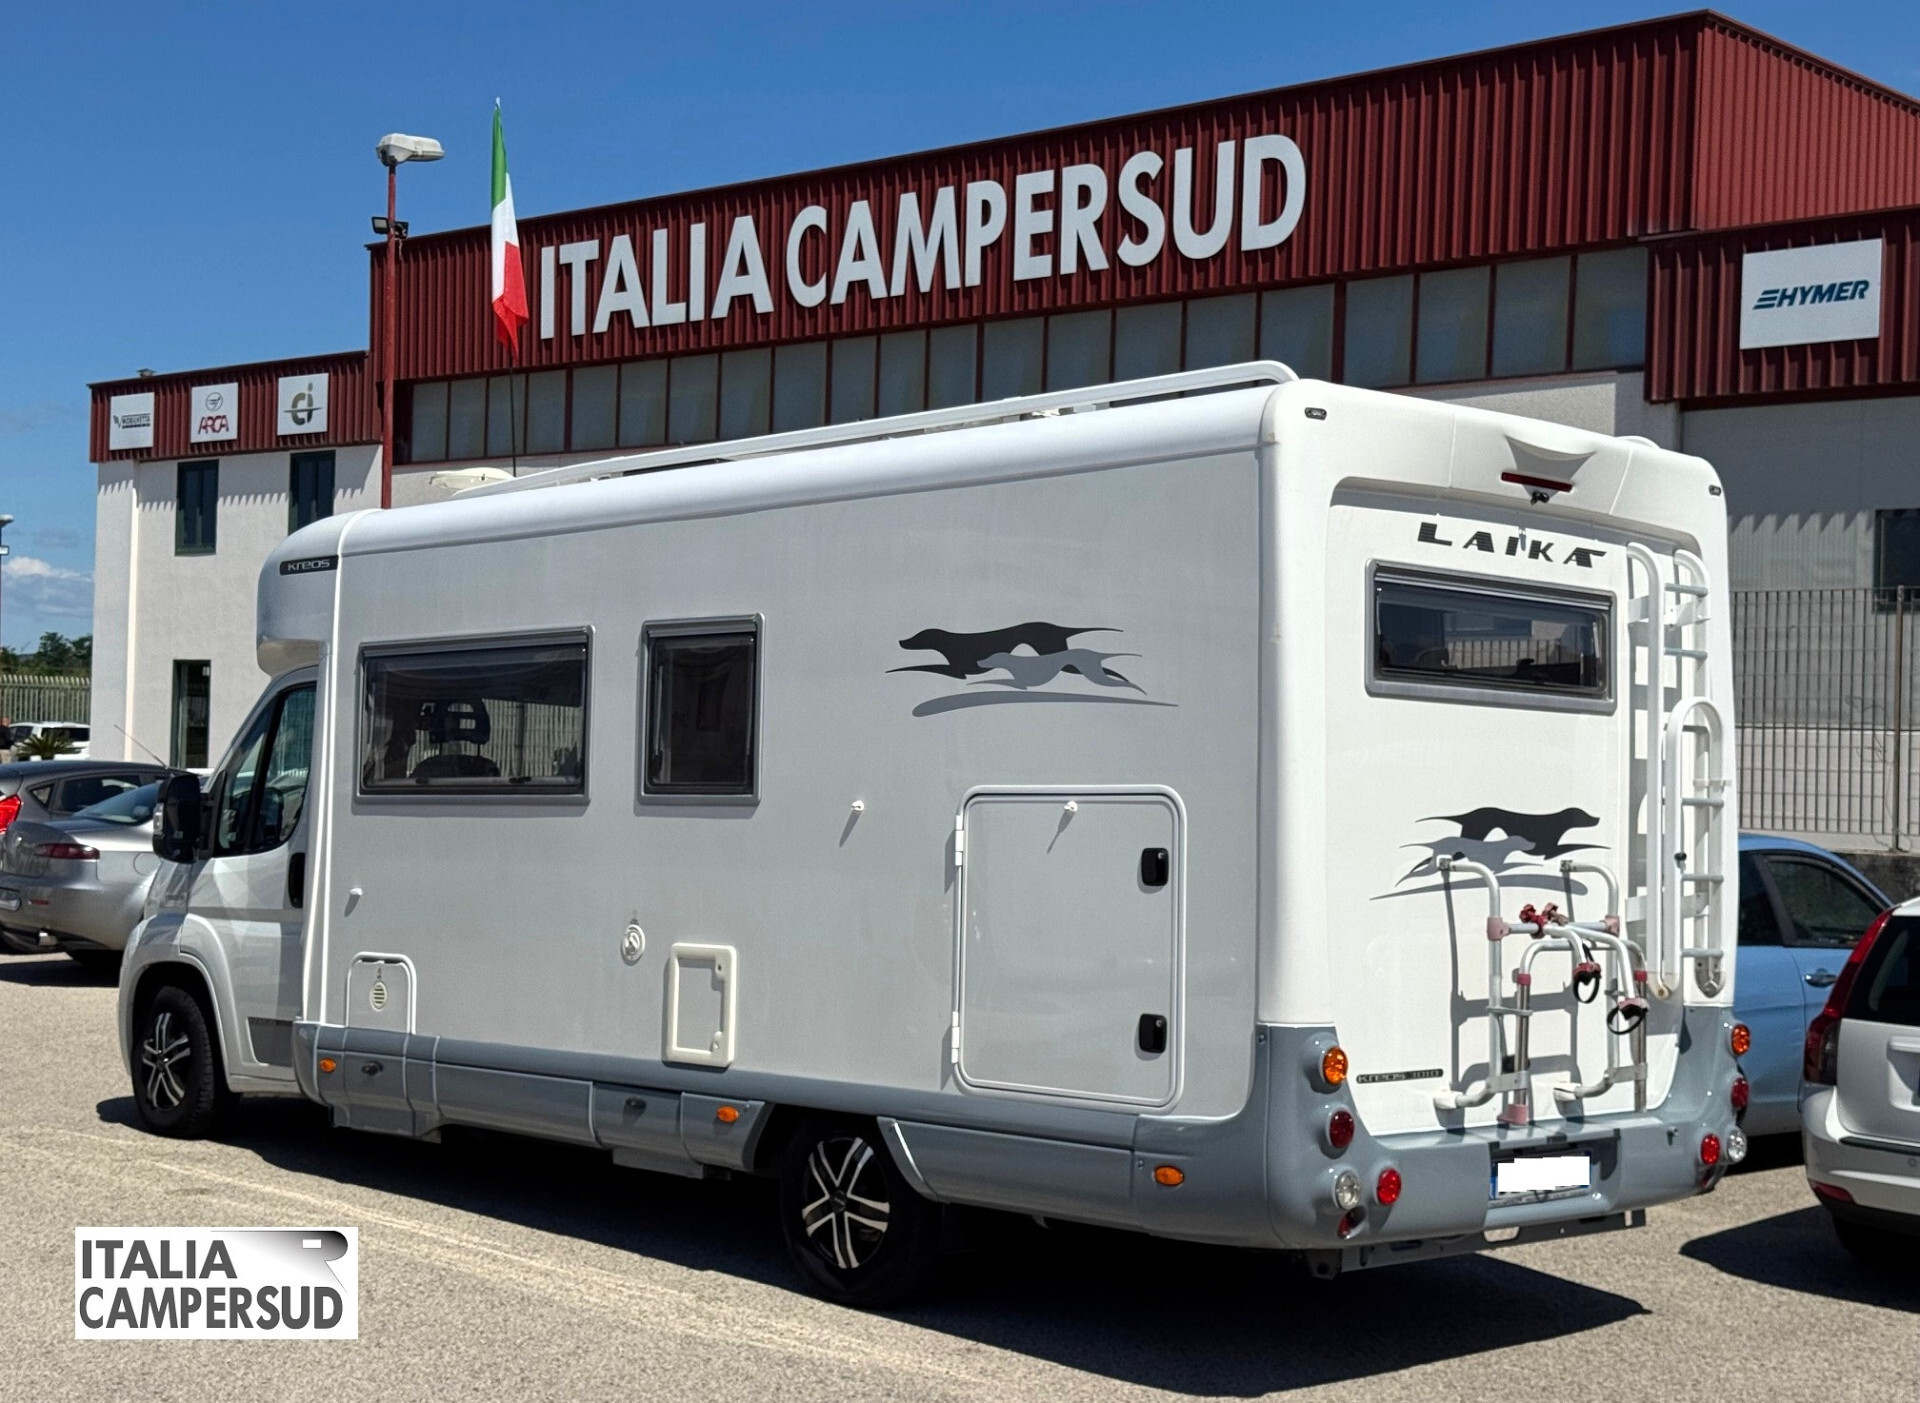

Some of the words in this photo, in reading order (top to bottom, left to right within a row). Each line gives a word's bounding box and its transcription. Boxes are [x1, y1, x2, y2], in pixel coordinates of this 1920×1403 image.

[540, 216, 774, 340] ITALIA
[785, 133, 1307, 308] CAMPERSUD
[1776, 279, 1870, 308] HYMER
[198, 415, 230, 434] ARCA
[1417, 521, 1607, 568] LAIKA
